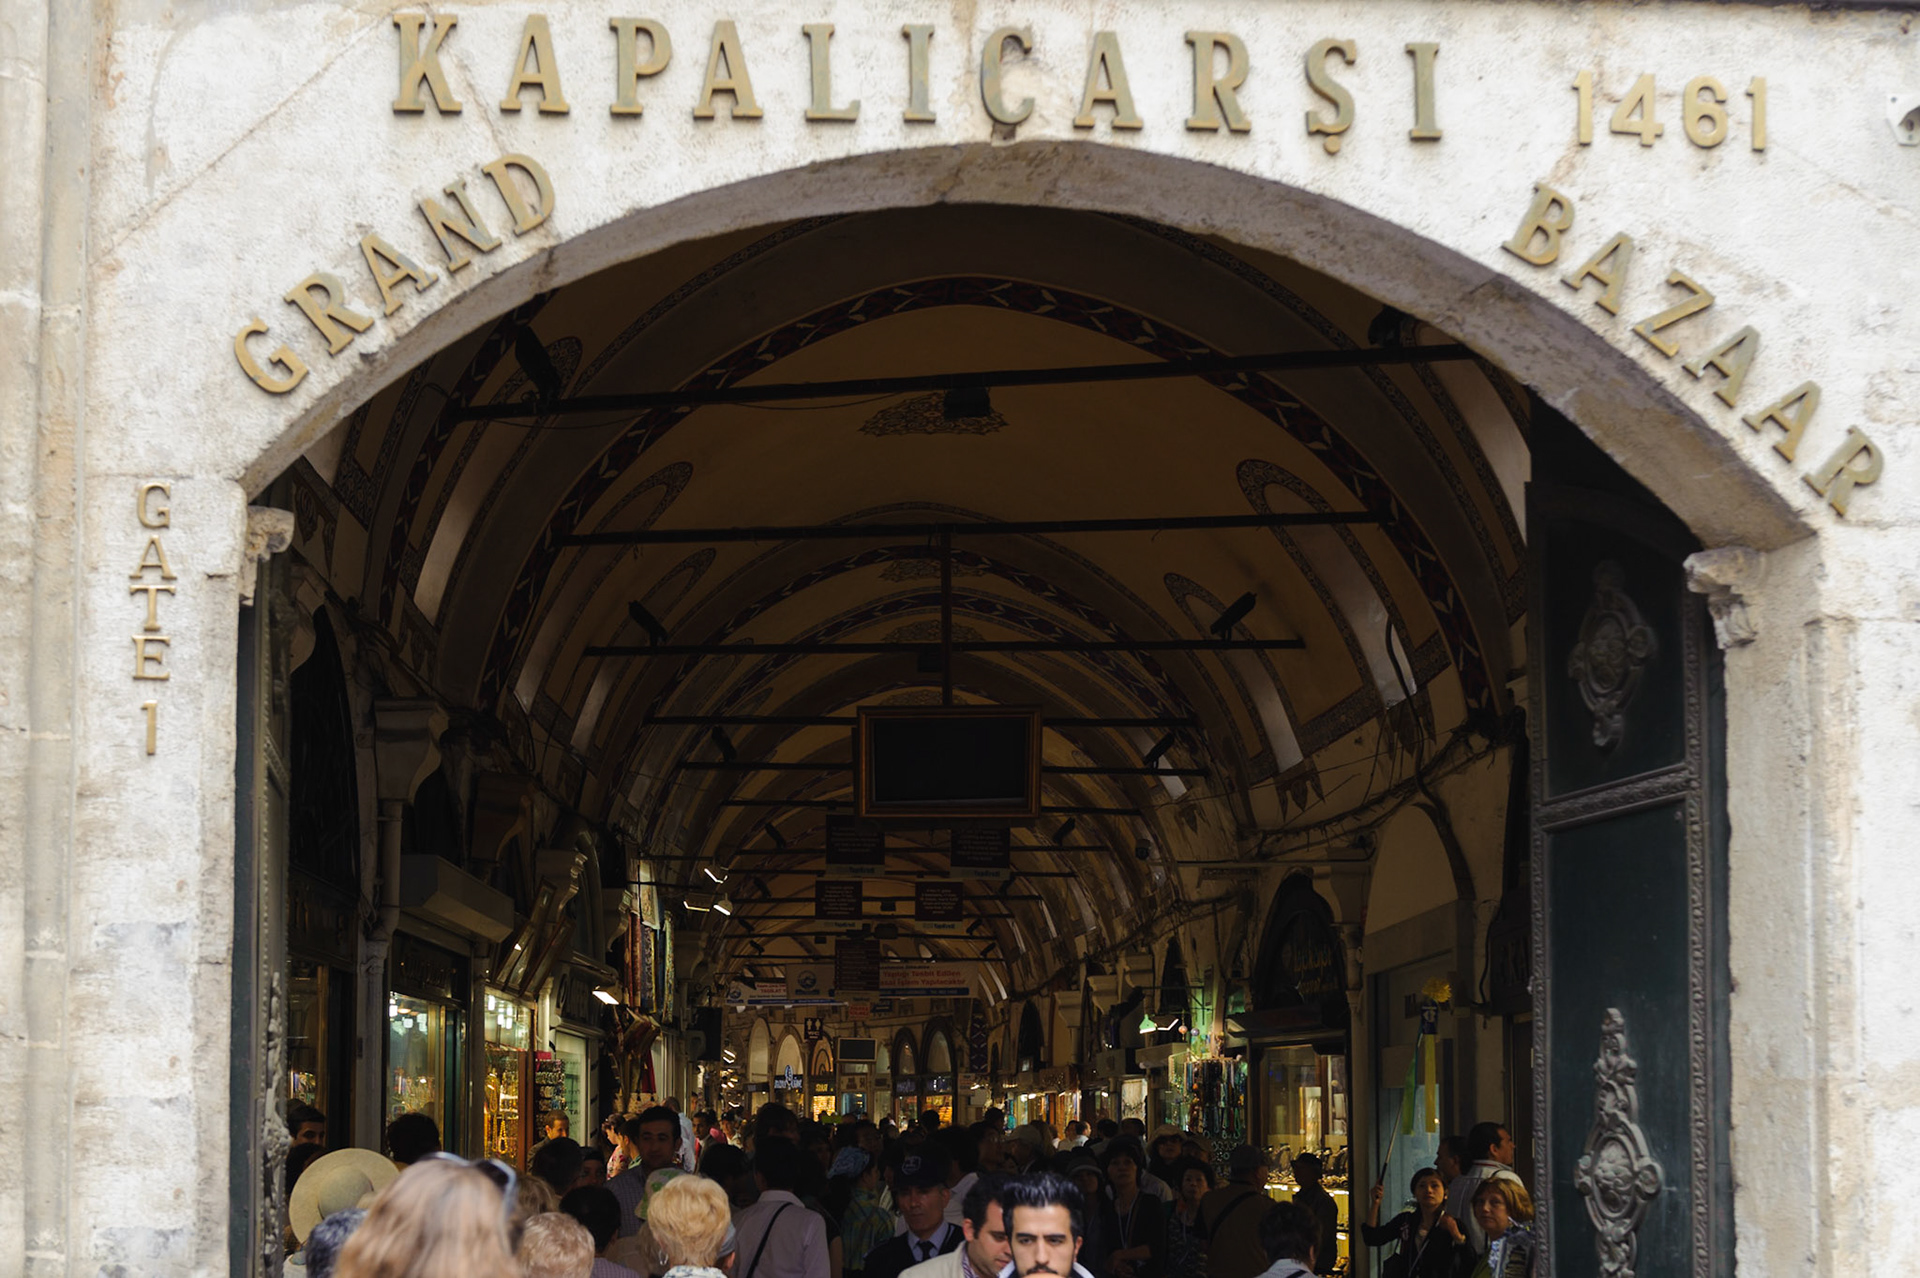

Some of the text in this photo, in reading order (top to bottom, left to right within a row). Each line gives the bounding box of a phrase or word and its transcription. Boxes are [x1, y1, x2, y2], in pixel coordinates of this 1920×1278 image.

[1571, 71, 1768, 152] 1461
[233, 152, 1886, 517] GRAND BAZAAR
[129, 482, 177, 756] GATE 1
